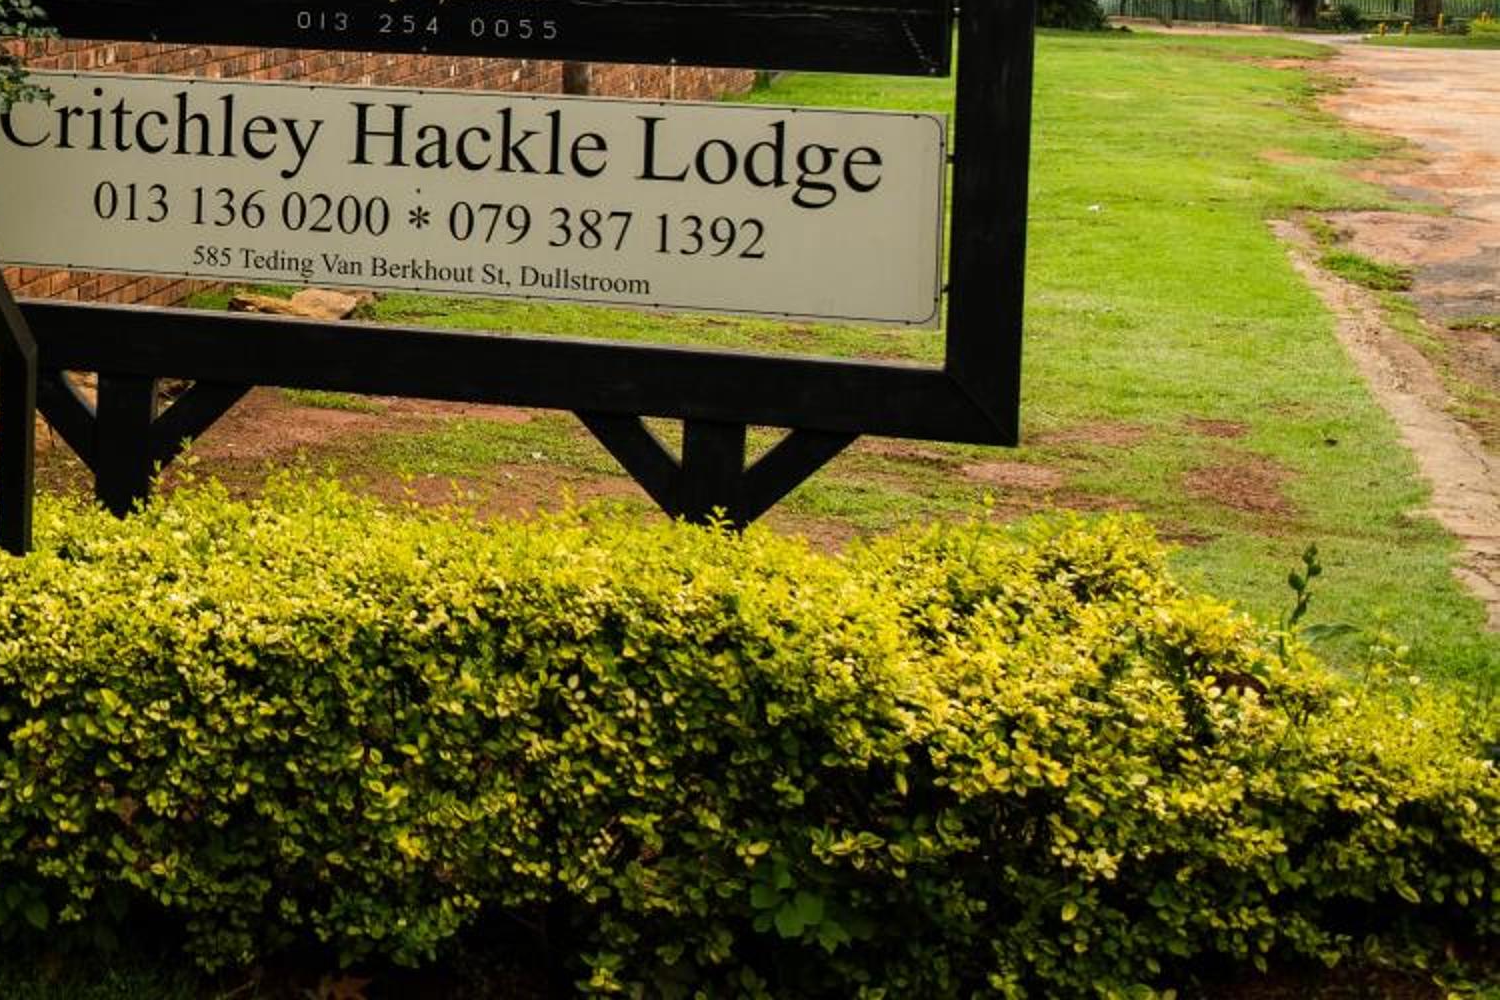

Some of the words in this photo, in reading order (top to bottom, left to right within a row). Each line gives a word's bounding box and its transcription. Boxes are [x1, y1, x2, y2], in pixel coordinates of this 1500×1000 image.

[297, 11, 347, 31] 013
[379, 15, 437, 34] 254
[471, 17, 555, 39] 0055
[348, 102, 608, 178] Hackle
[634, 116, 883, 209] Lodge
[93, 180, 169, 223] 013
[191, 186, 266, 229] 136
[281, 191, 390, 237] 0200
[449, 201, 531, 245] 079
[548, 207, 633, 251] 387
[655, 213, 766, 259] 1392
[193, 245, 231, 267] 585
[240, 248, 314, 275] Teding
[321, 253, 362, 276] Van
[371, 257, 474, 283] Berkhout
[481, 263, 511, 289] St,
[520, 265, 651, 295] Dullstroom
